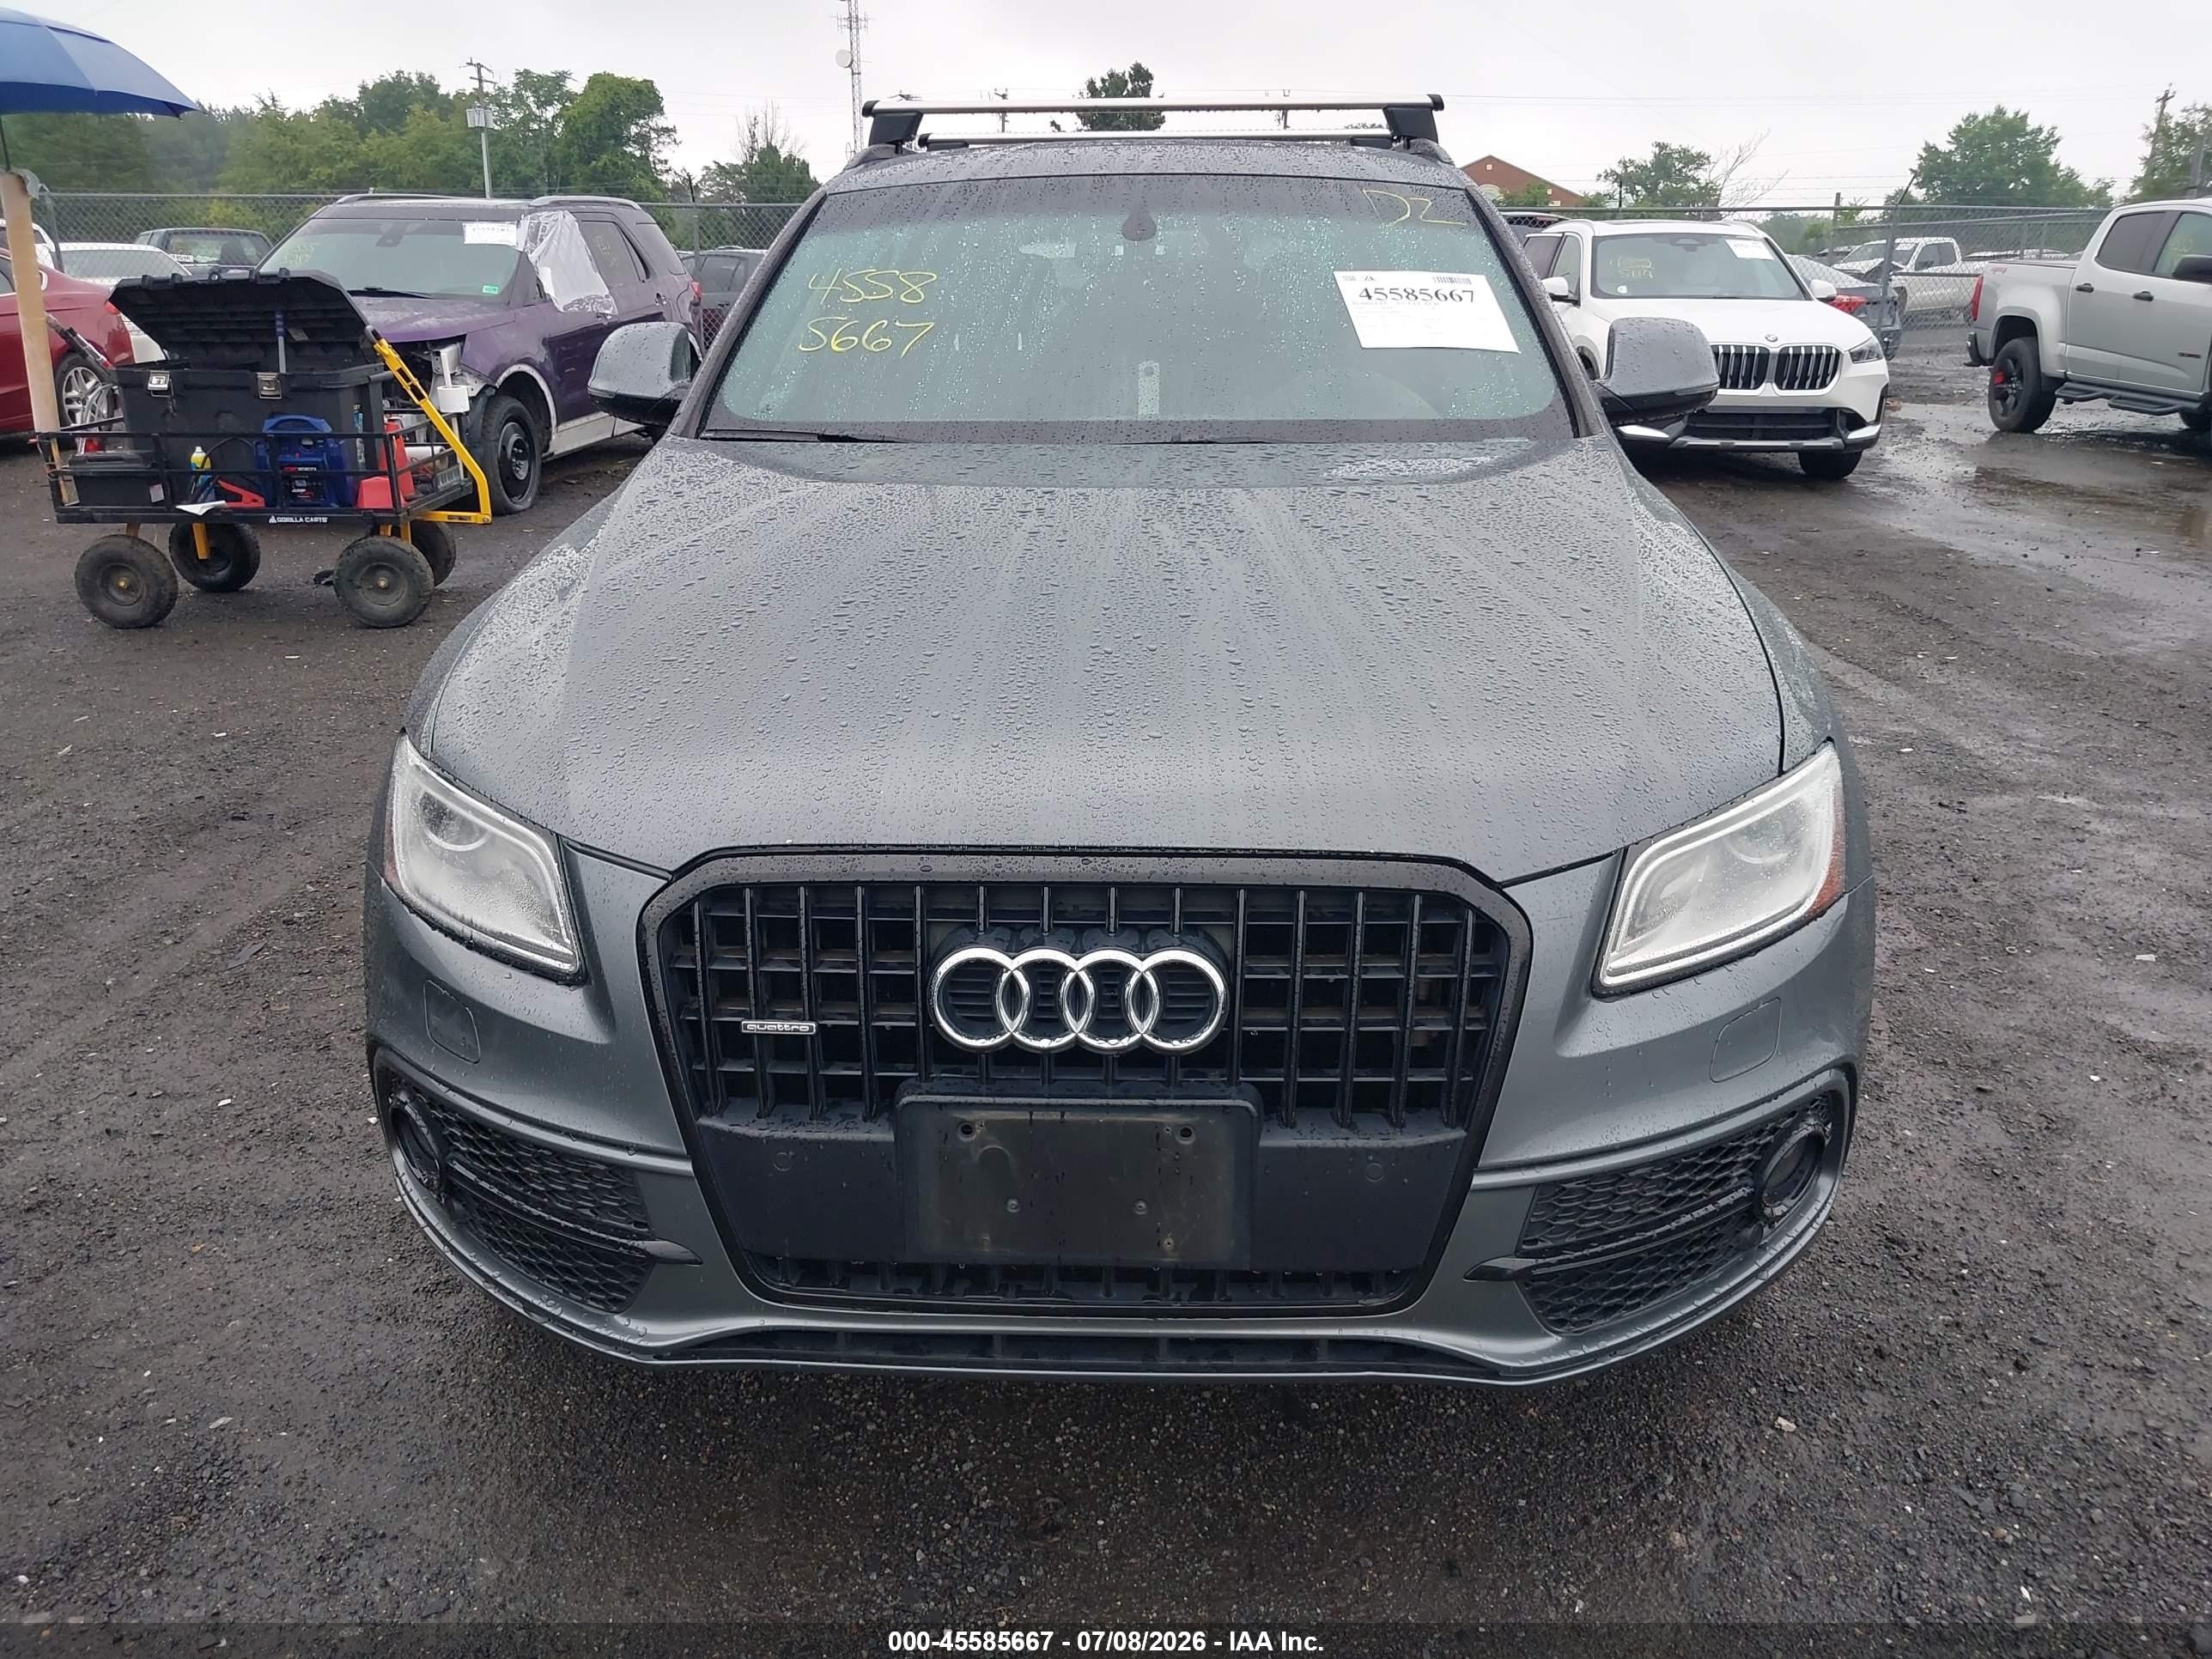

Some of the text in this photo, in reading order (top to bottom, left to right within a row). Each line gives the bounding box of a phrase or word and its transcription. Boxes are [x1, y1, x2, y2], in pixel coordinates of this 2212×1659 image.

[808, 267, 938, 304] 4558
[1358, 287, 1475, 303] 45585667
[799, 316, 936, 359] 5667
[746, 1024, 810, 1032] quattro
